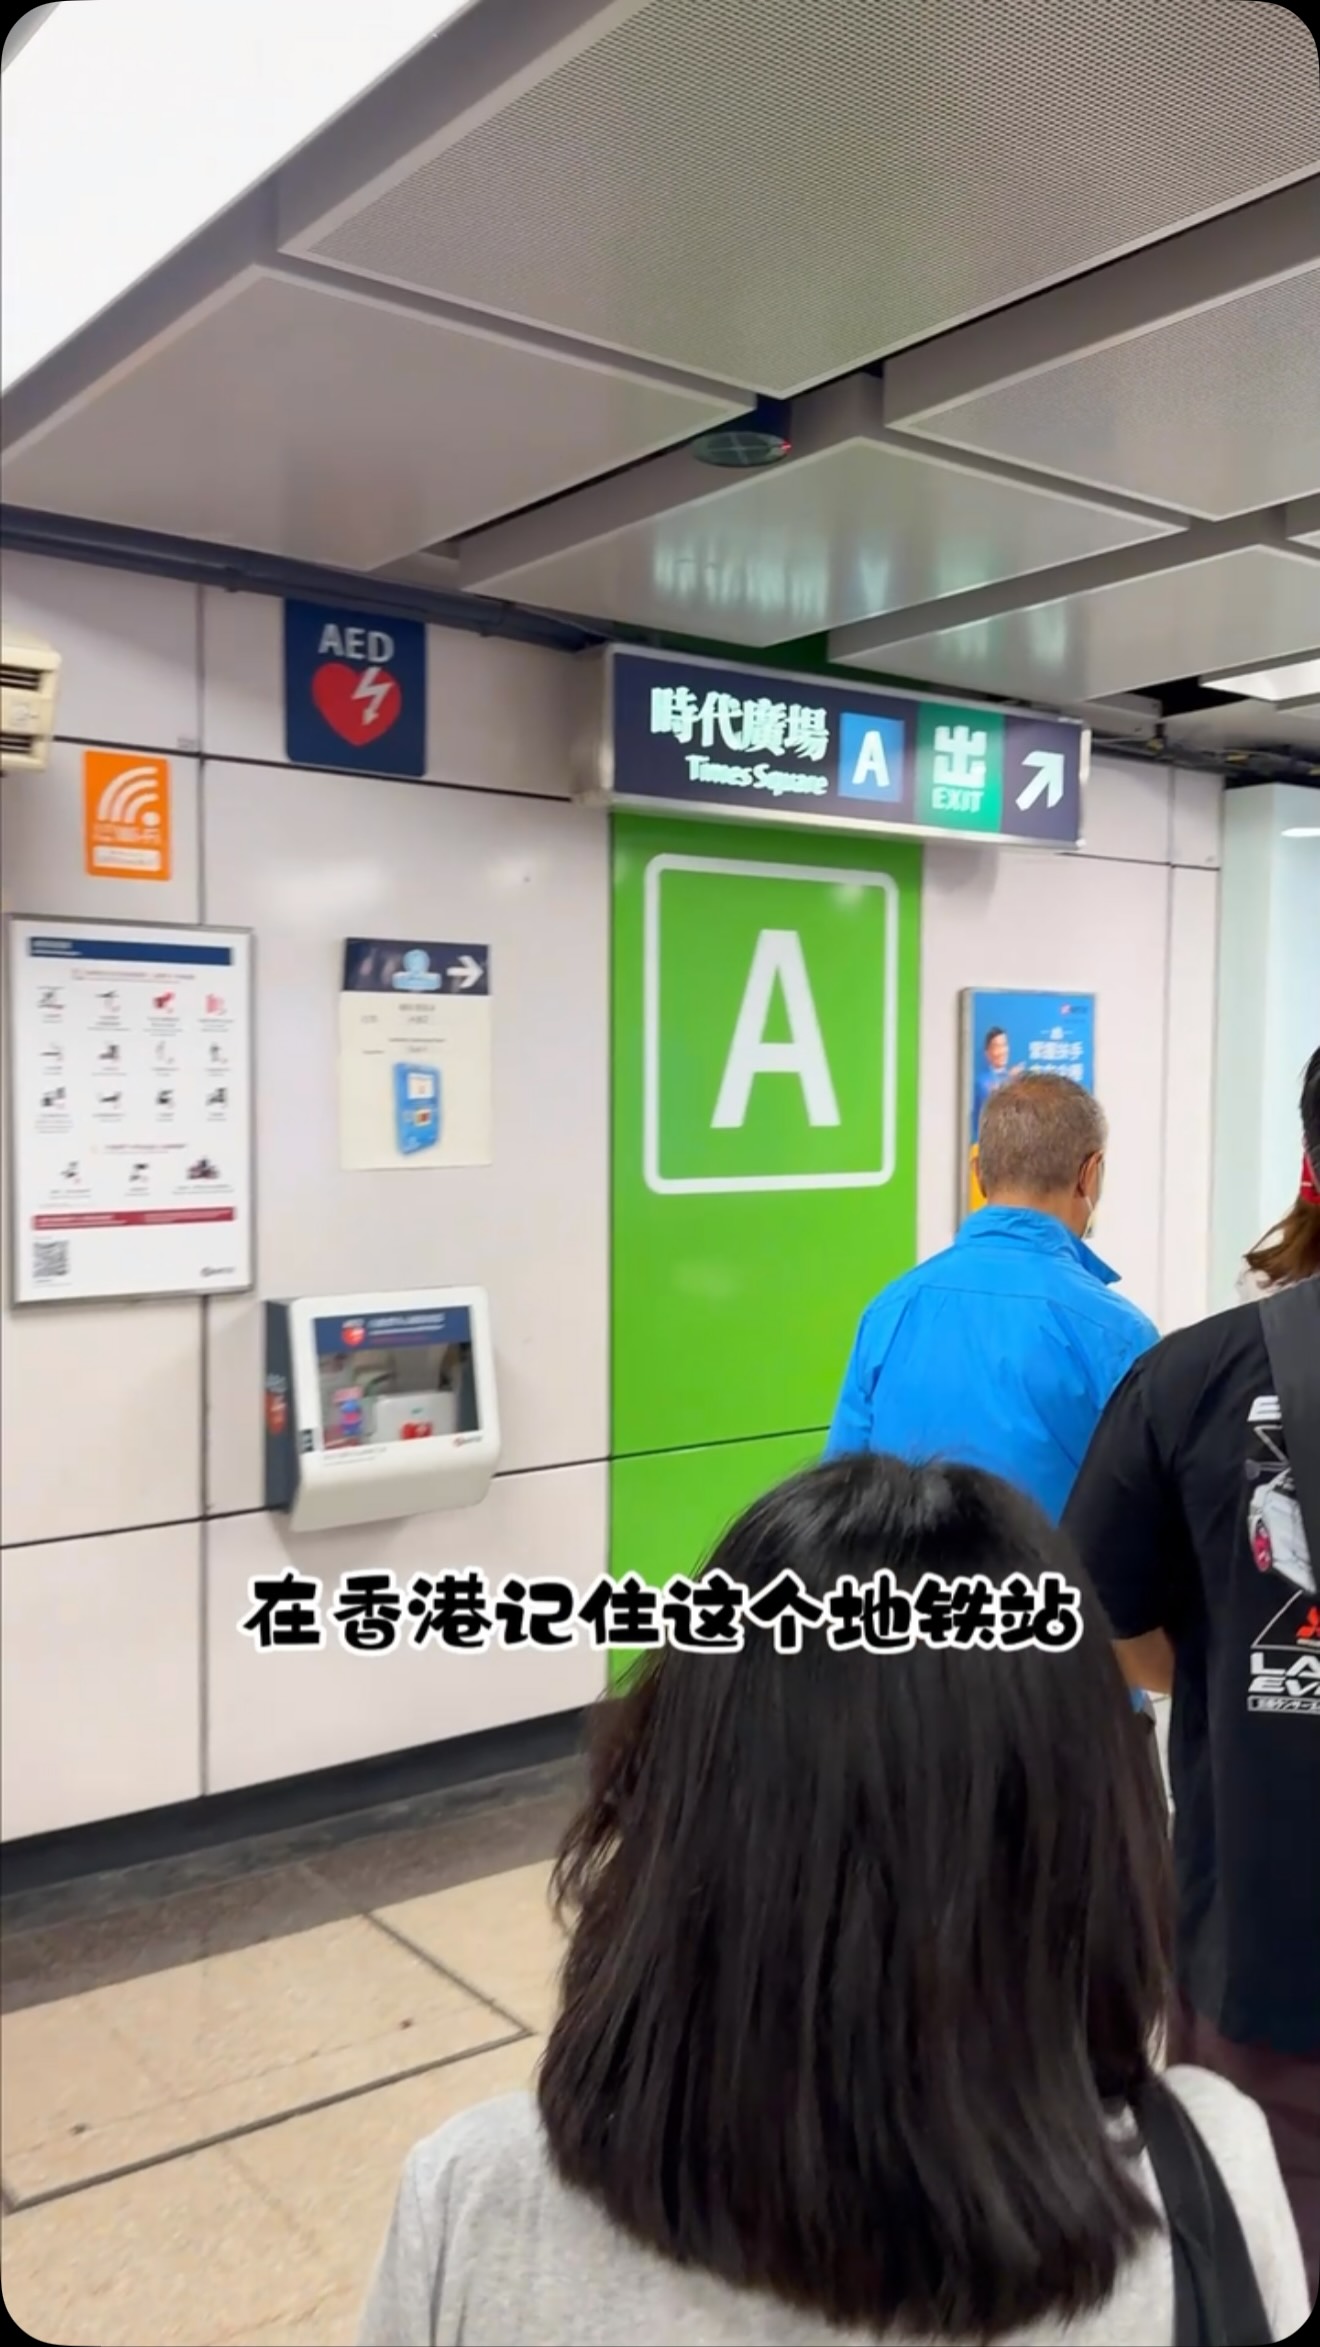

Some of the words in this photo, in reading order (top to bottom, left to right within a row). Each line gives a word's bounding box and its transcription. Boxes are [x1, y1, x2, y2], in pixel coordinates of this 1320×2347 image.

[317, 623, 395, 663] AED
[650, 685, 830, 762] 時代廣場
[684, 753, 753, 787] Times
[752, 763, 829, 797] Square
[851, 730, 890, 787] A
[932, 725, 987, 789] 出
[931, 788, 985, 813] EXIT
[710, 929, 841, 1128] A
